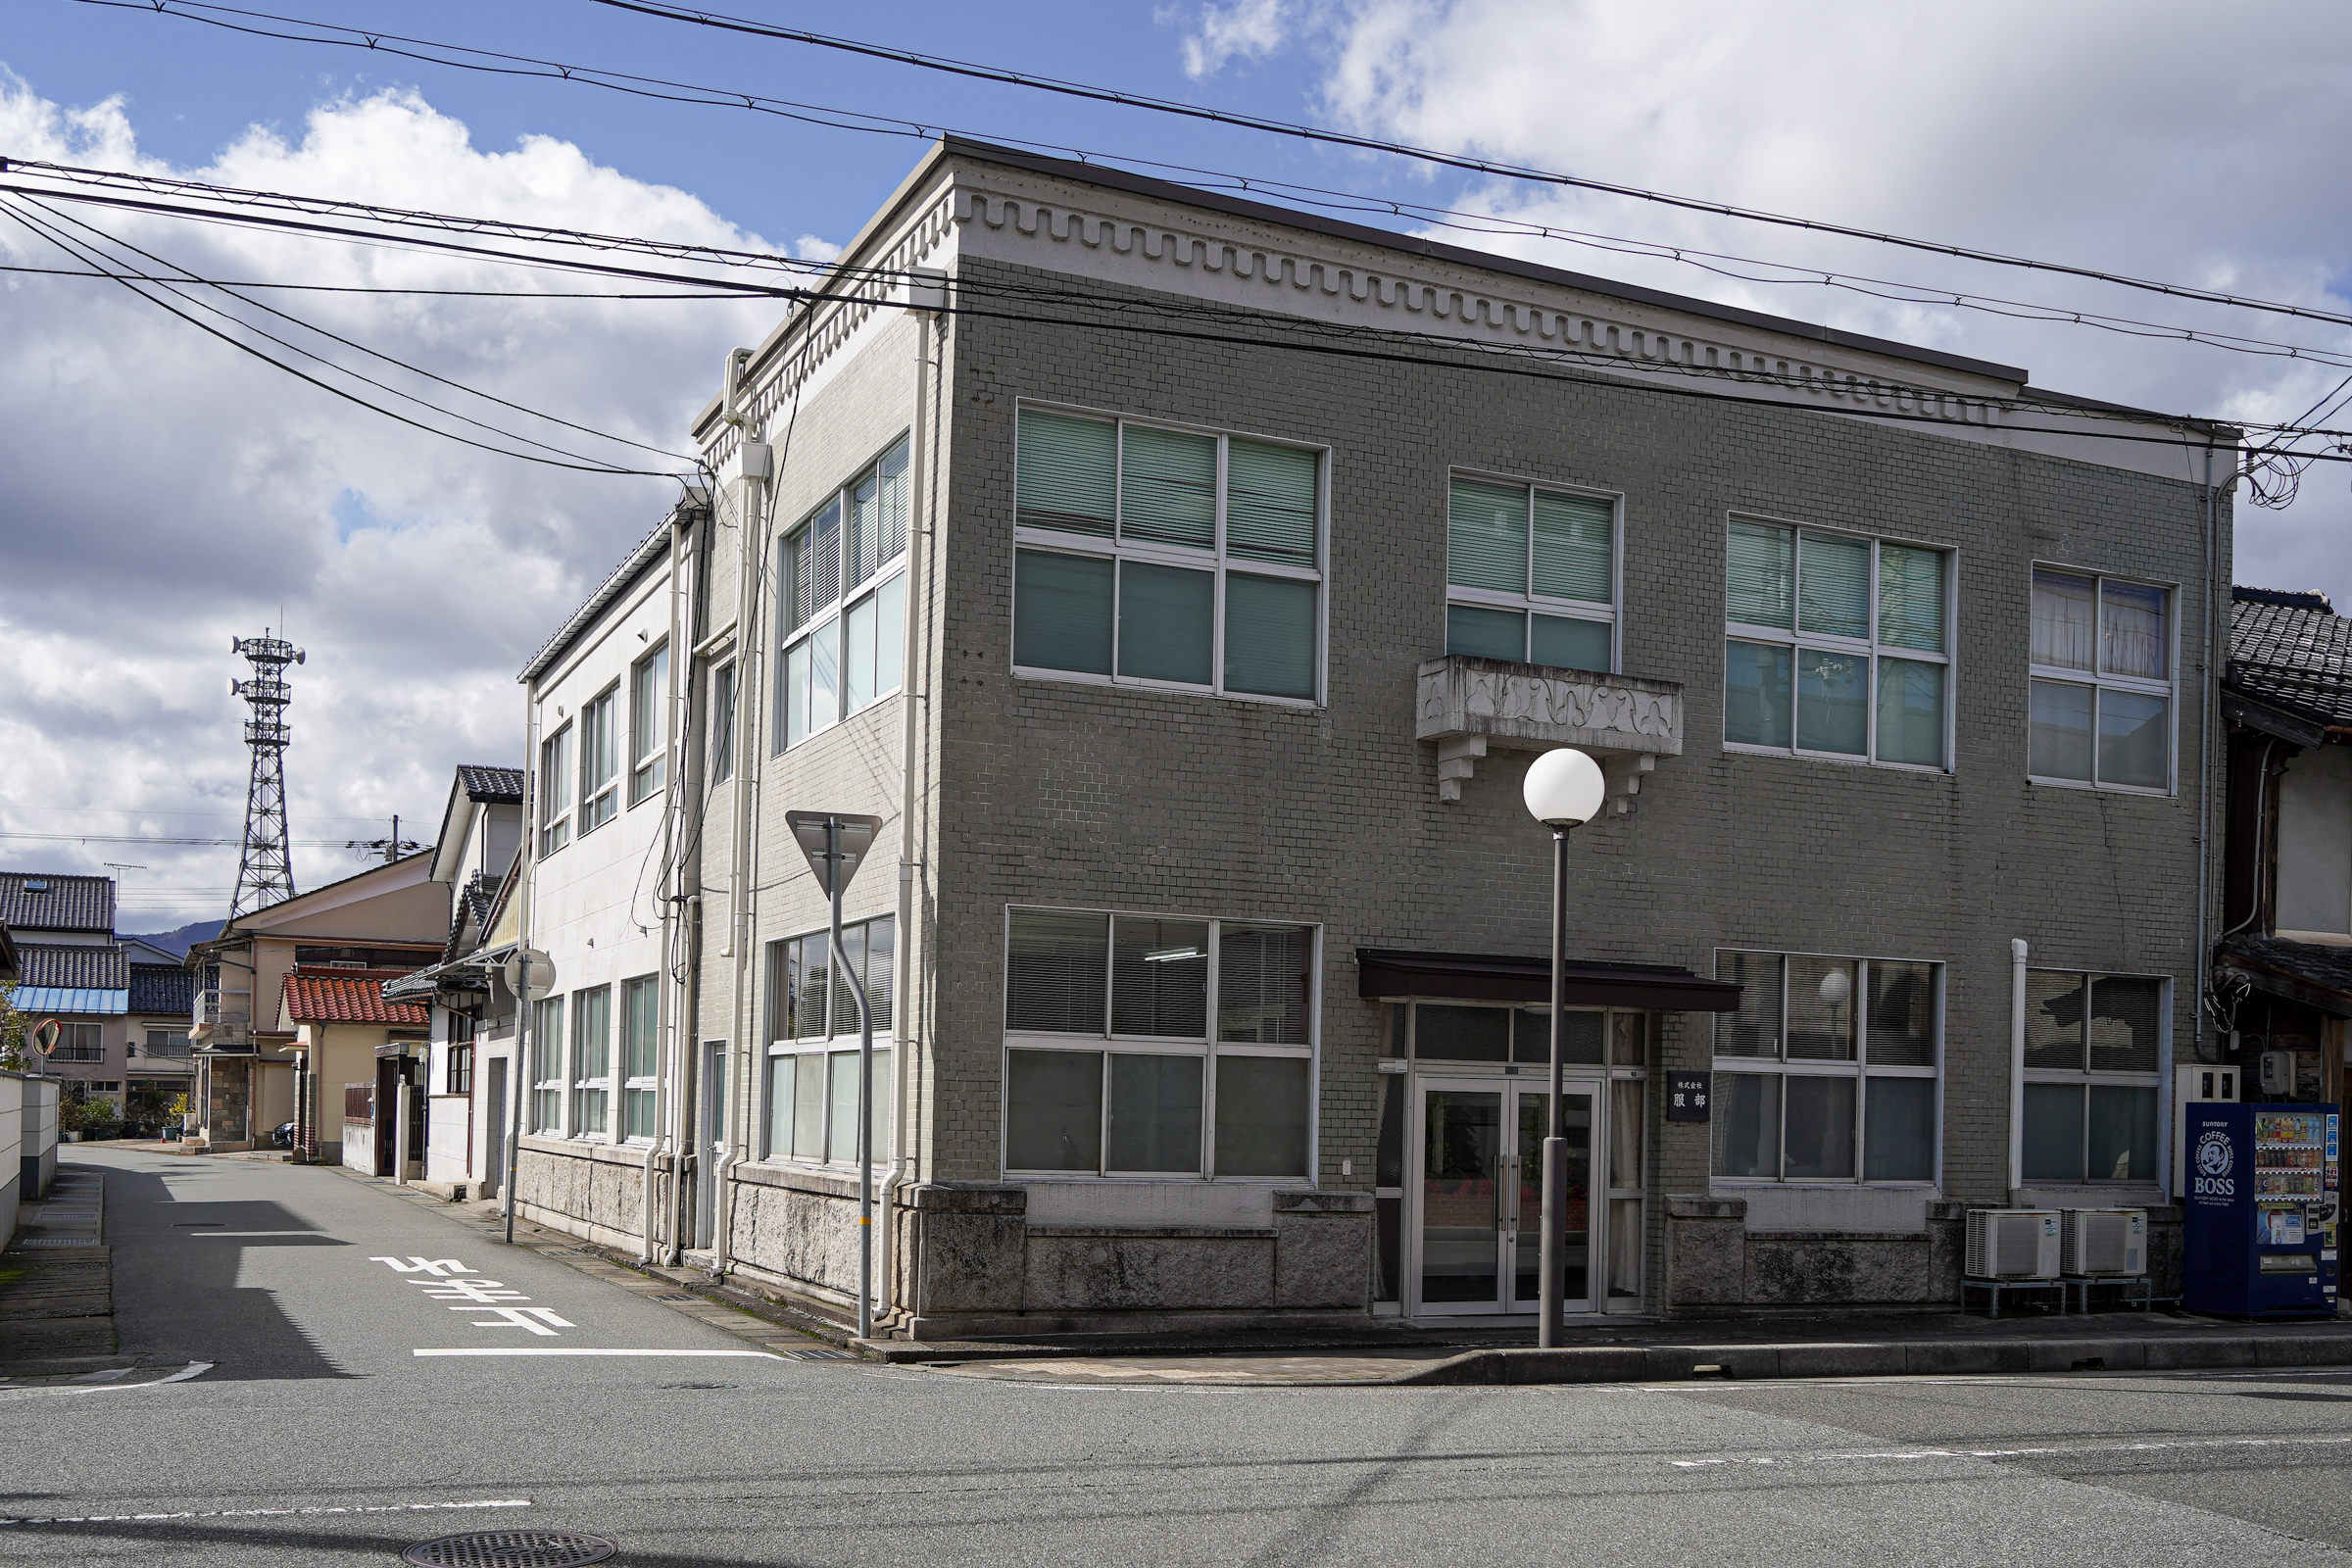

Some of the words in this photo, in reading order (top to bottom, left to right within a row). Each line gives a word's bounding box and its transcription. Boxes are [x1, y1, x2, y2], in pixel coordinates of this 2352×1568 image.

[1674, 1093, 1706, 1107] 服部
[2199, 1131, 2230, 1146] COFFEE
[2194, 1177, 2234, 1195] BOSS
[368, 1256, 577, 1336] 止まれ
